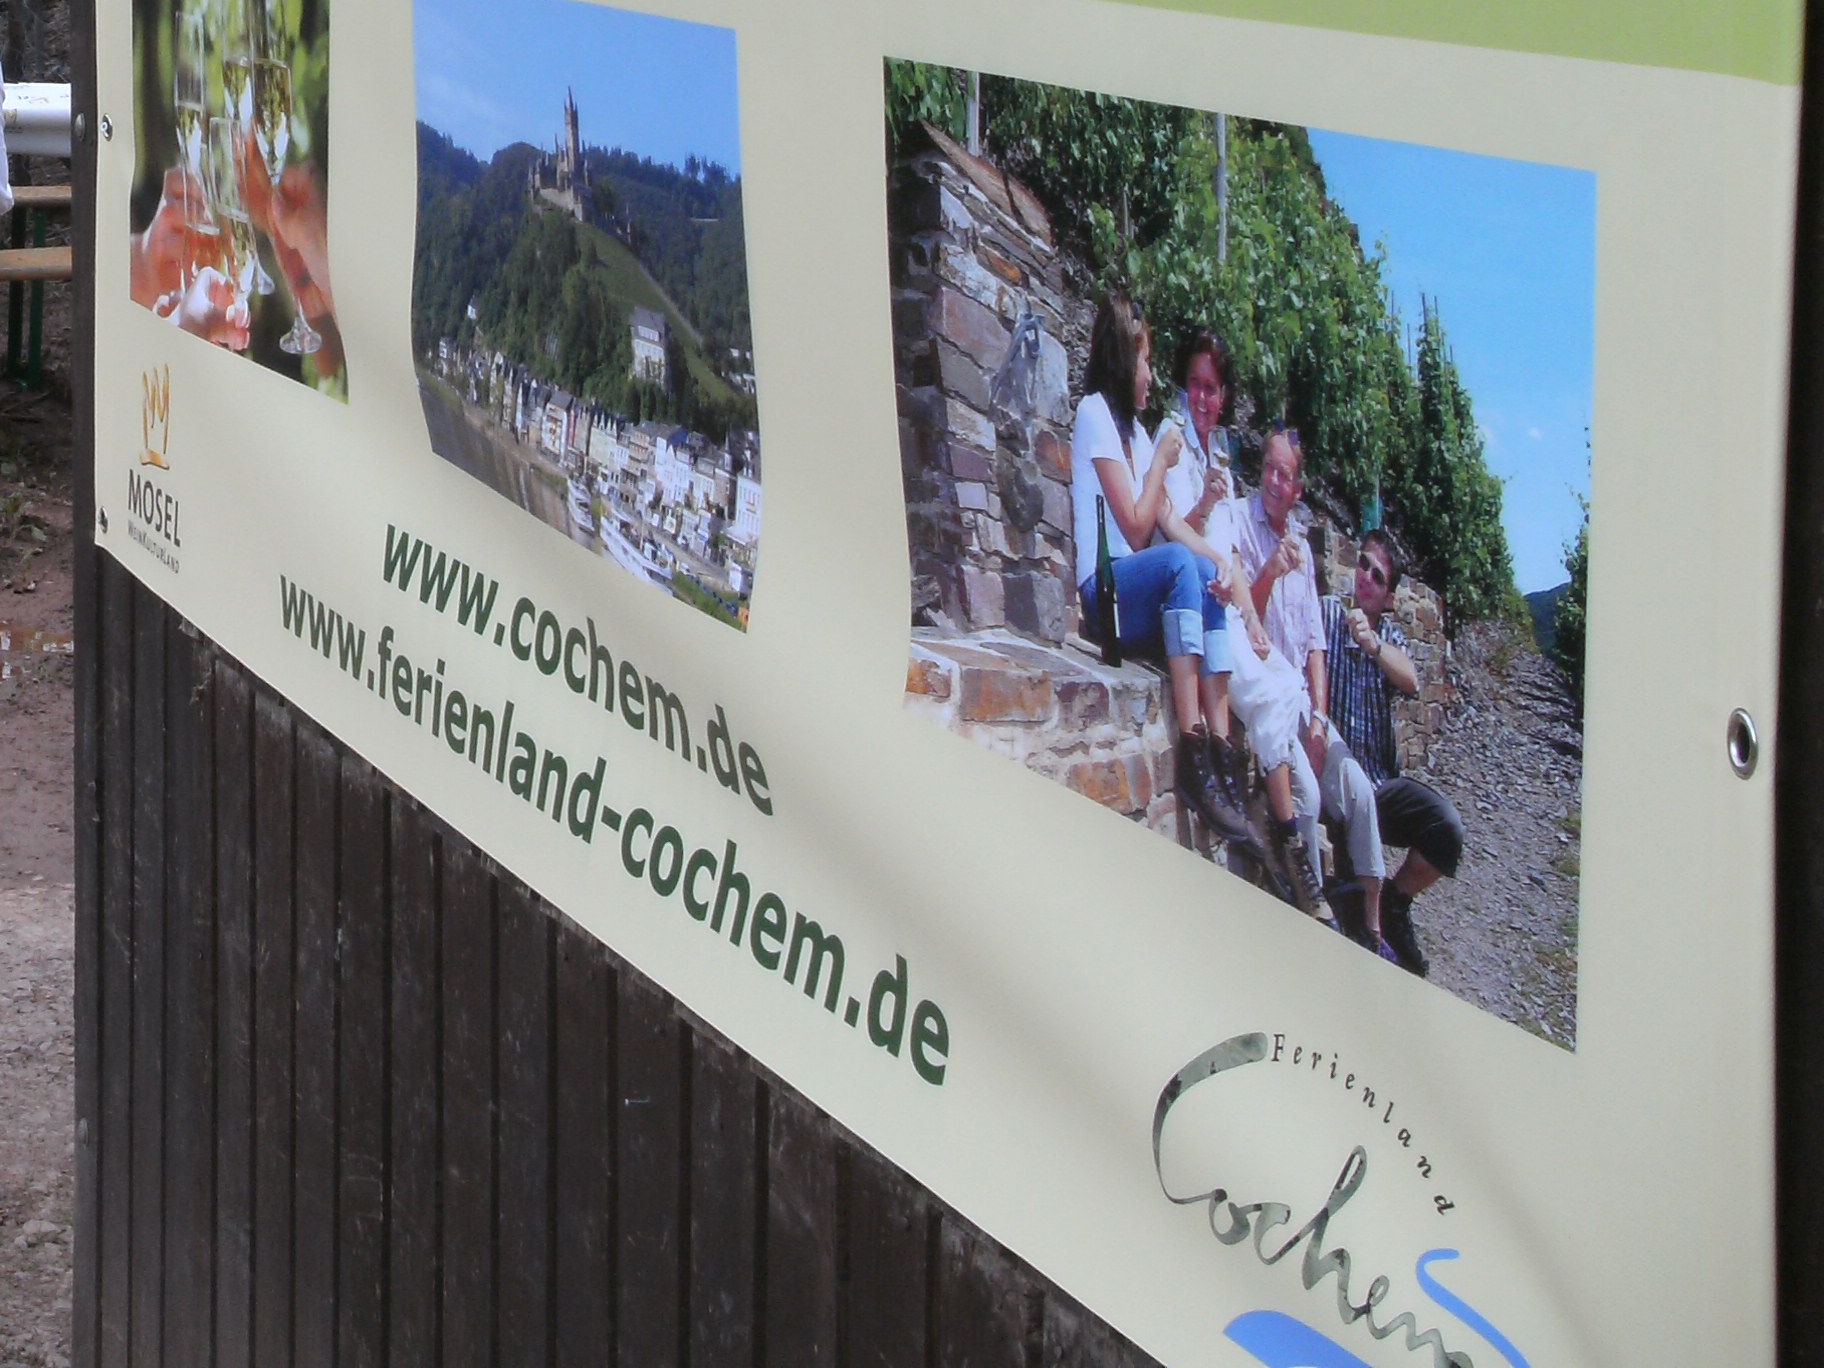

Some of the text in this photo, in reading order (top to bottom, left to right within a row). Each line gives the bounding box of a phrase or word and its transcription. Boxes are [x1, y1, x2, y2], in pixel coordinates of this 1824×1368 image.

[128, 469, 181, 548] MOSEL
[381, 523, 774, 817] www.cochem.de
[279, 574, 950, 1087] www.ferienland-cochem.de
[1271, 1033, 1455, 1216] Ferienland
